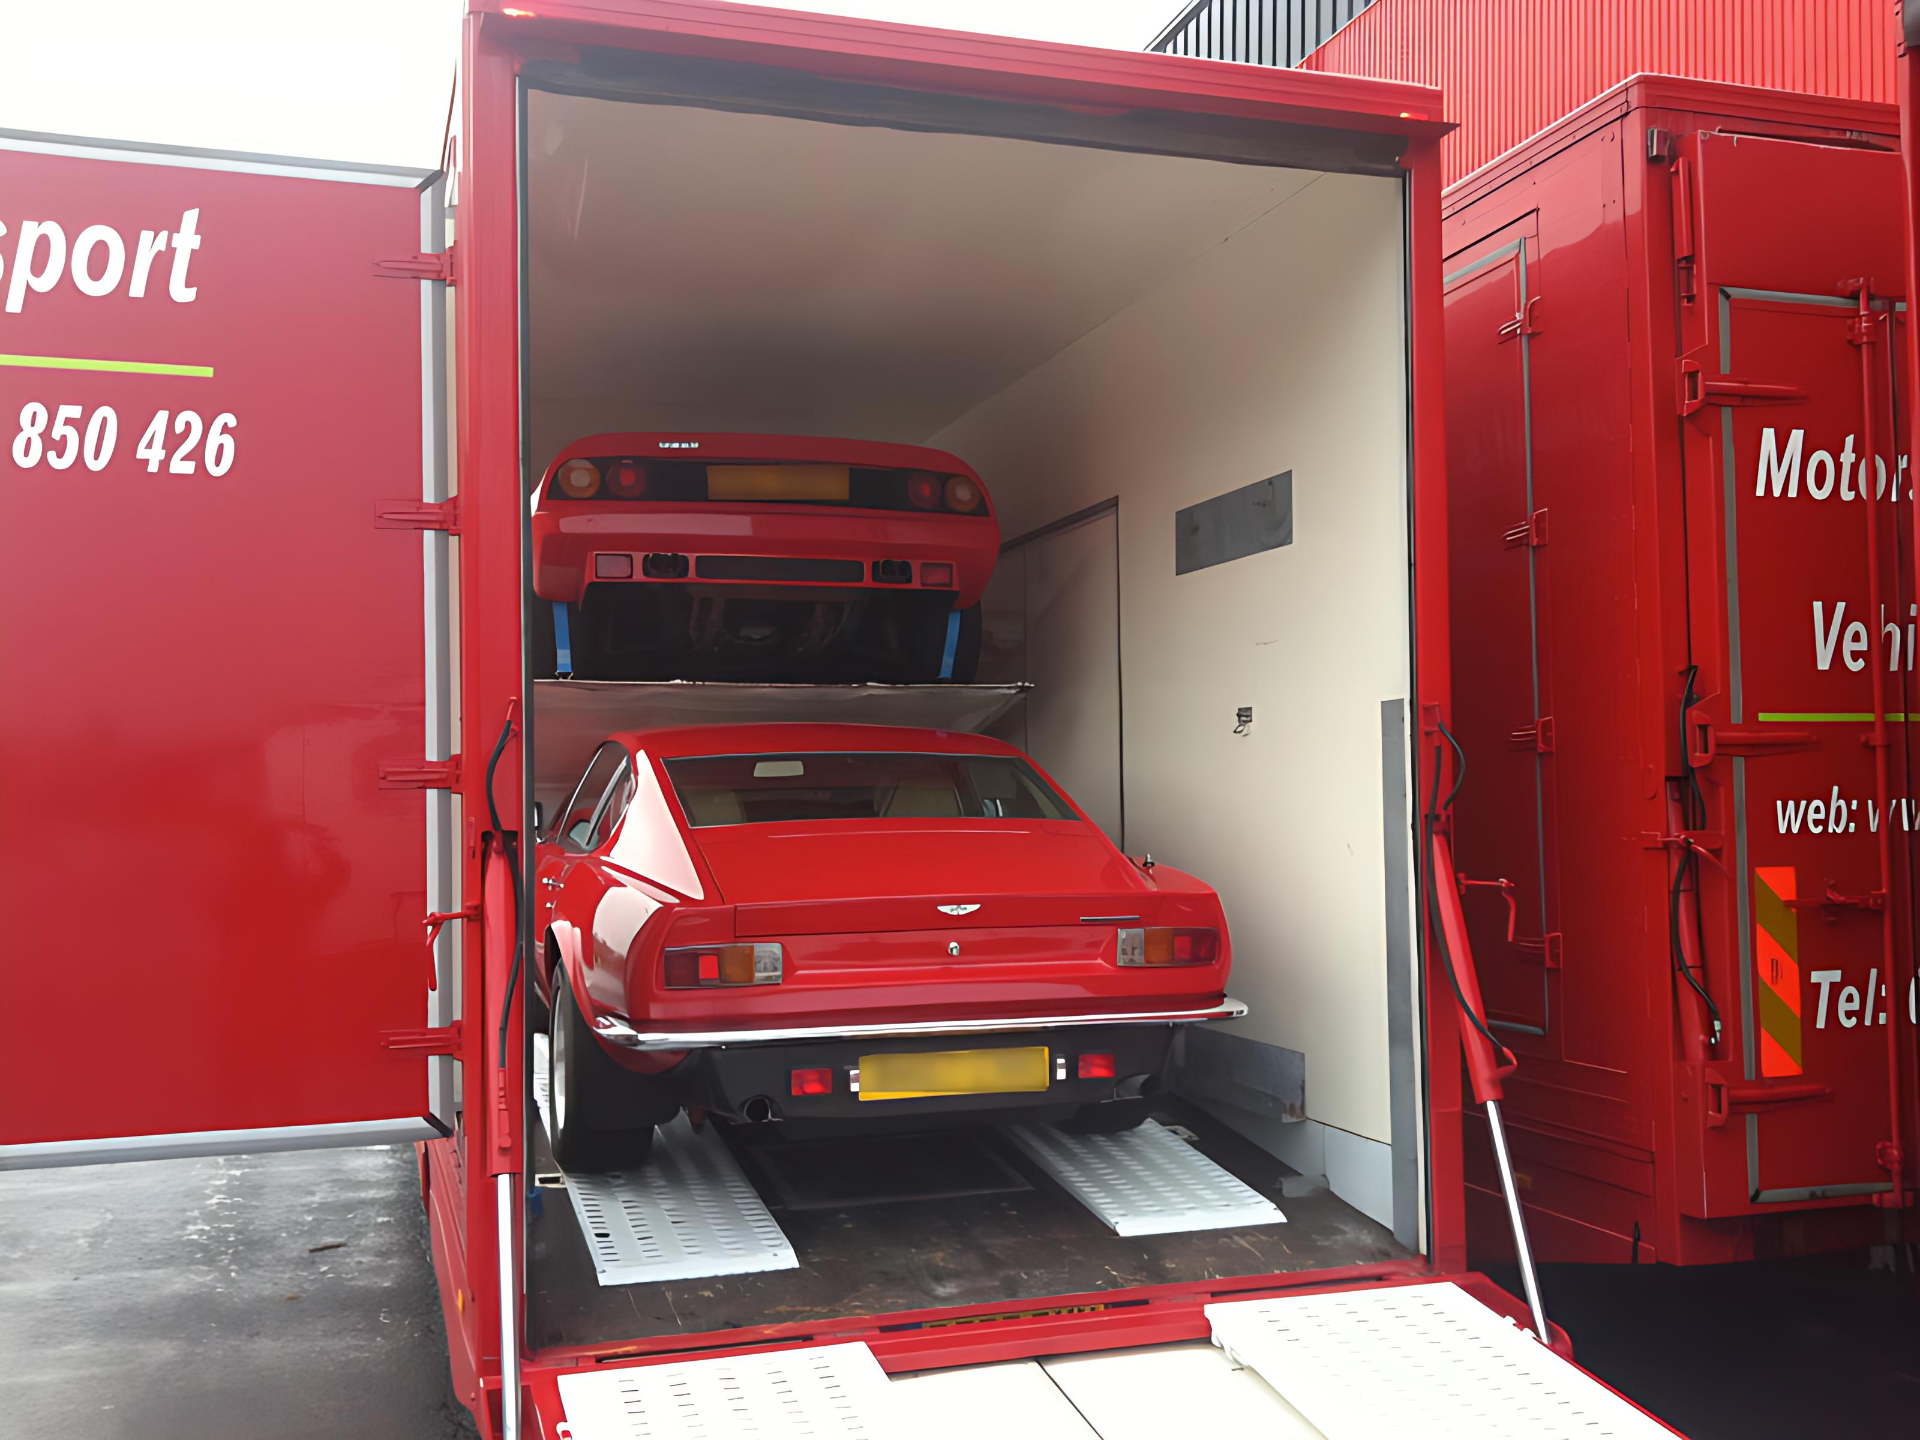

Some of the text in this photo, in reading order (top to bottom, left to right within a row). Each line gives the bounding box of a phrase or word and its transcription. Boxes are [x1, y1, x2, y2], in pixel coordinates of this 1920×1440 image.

[0, 207, 202, 314] port
[11, 401, 238, 477] 850 426
[1755, 427, 1913, 502] Motor
[1776, 785, 1858, 834] web:
[1810, 968, 1887, 1029] Tel:
